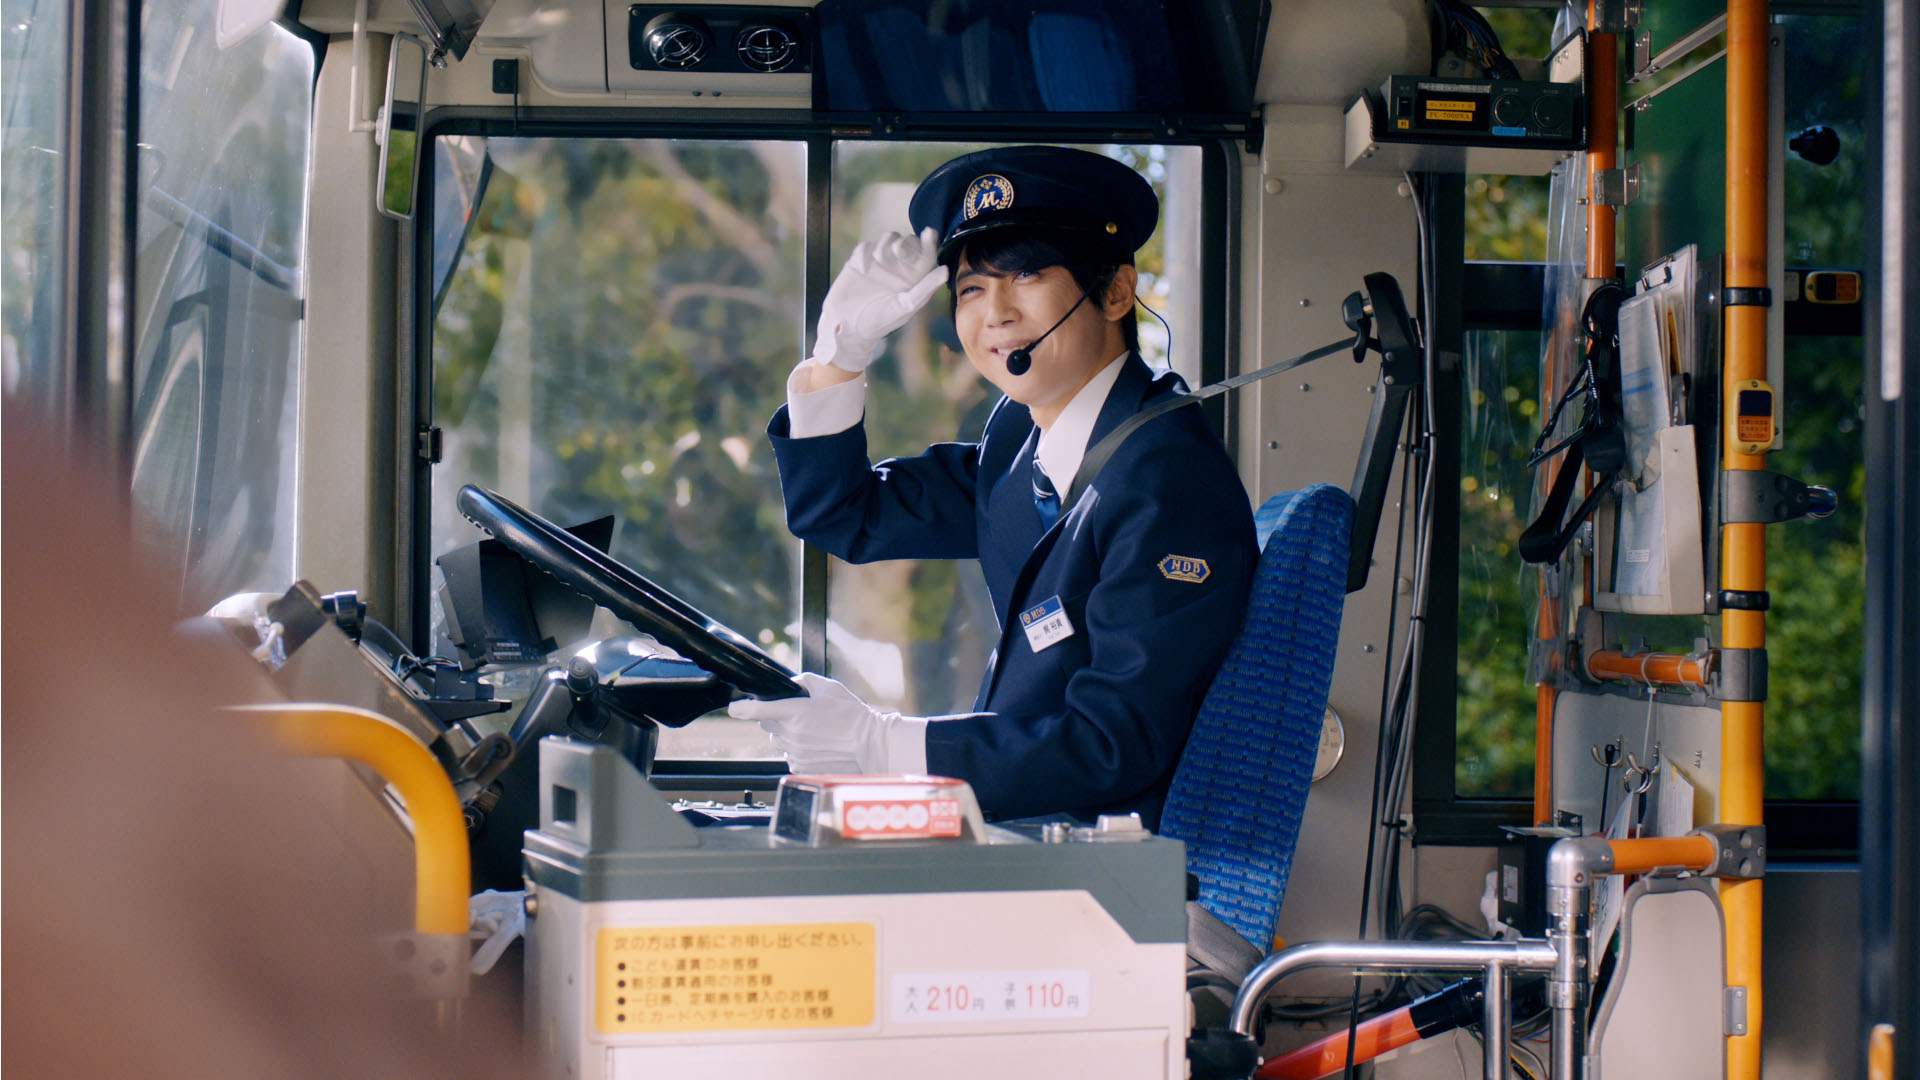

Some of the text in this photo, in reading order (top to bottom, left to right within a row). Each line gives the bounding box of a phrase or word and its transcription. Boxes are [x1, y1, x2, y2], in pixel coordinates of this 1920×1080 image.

[976, 190, 1000, 210] M
[613, 932, 863, 951] 次の方は事前にお申し出ください。
[631, 957, 758, 972] こども運賃のお客様
[906, 986, 918, 1014] 大人
[1005, 982, 1017, 1011] 子供
